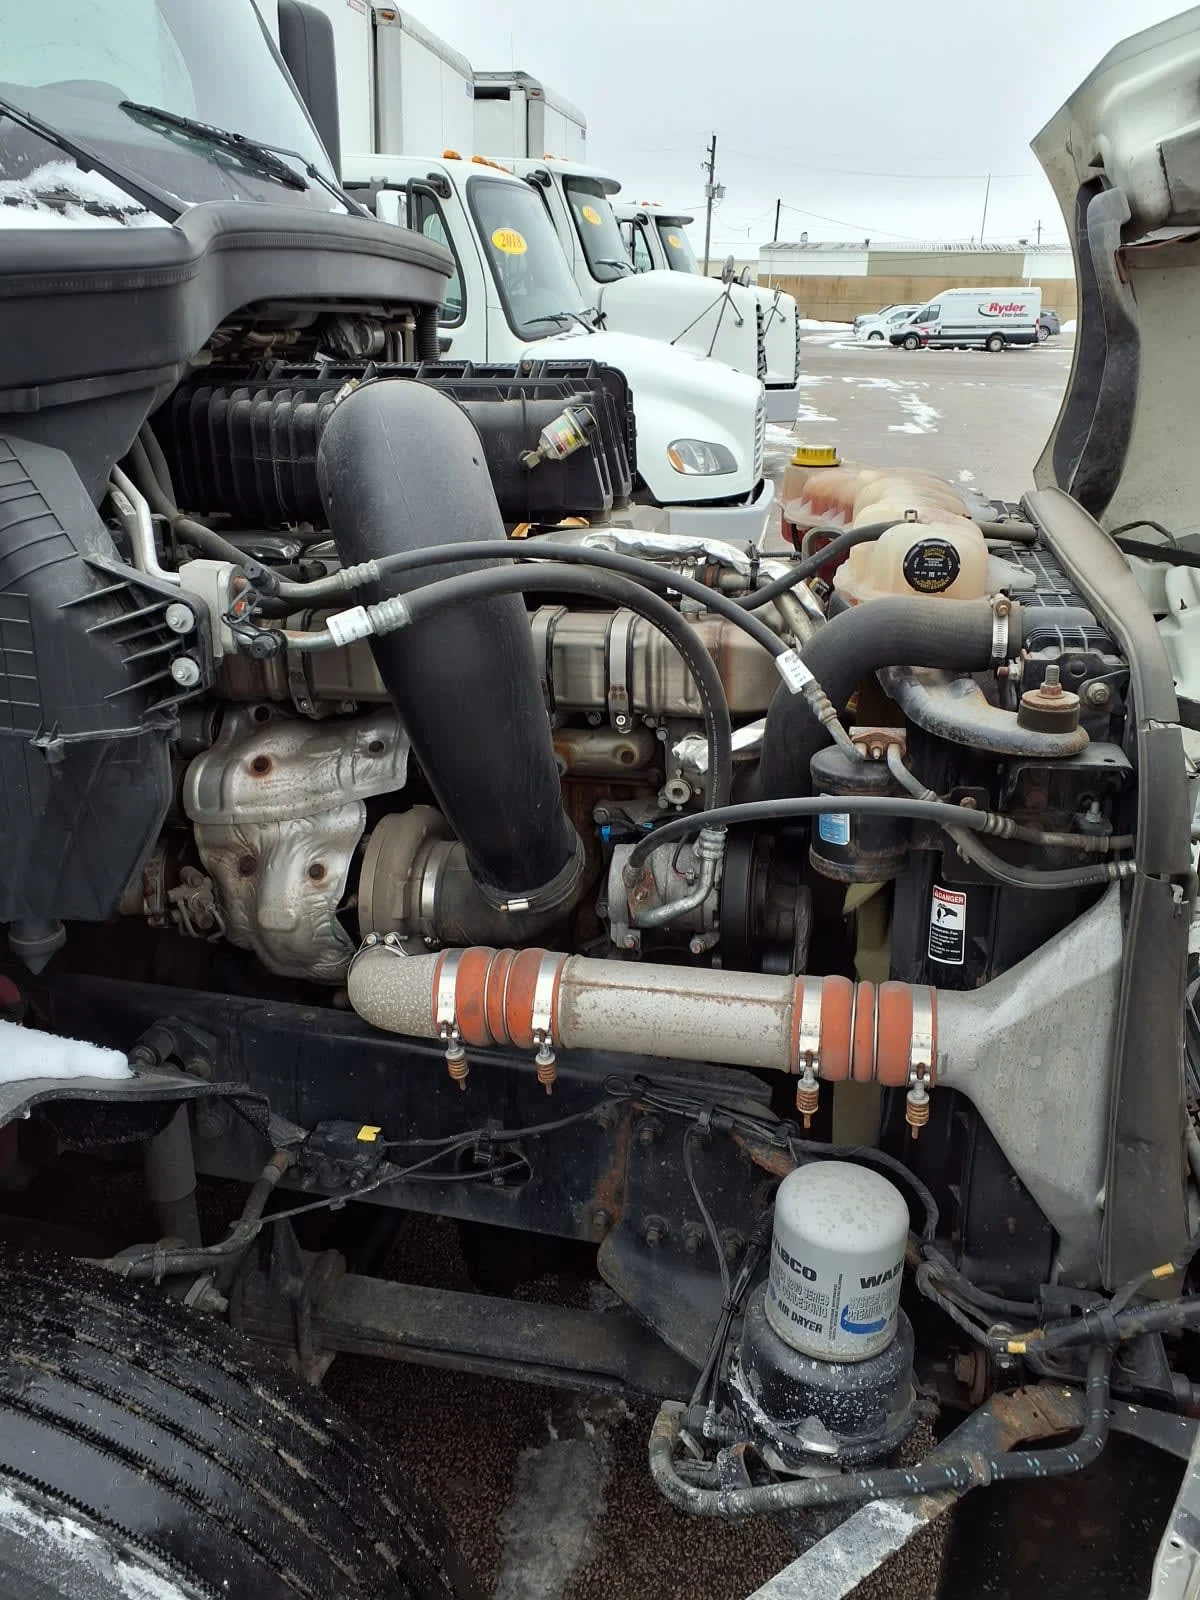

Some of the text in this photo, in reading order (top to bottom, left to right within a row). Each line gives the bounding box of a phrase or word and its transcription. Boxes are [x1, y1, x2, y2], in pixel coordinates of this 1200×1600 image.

[989, 302, 1025, 313] Ryder
[938, 892, 964, 904] DANGER
[778, 1299, 823, 1334] AIR DRYER
